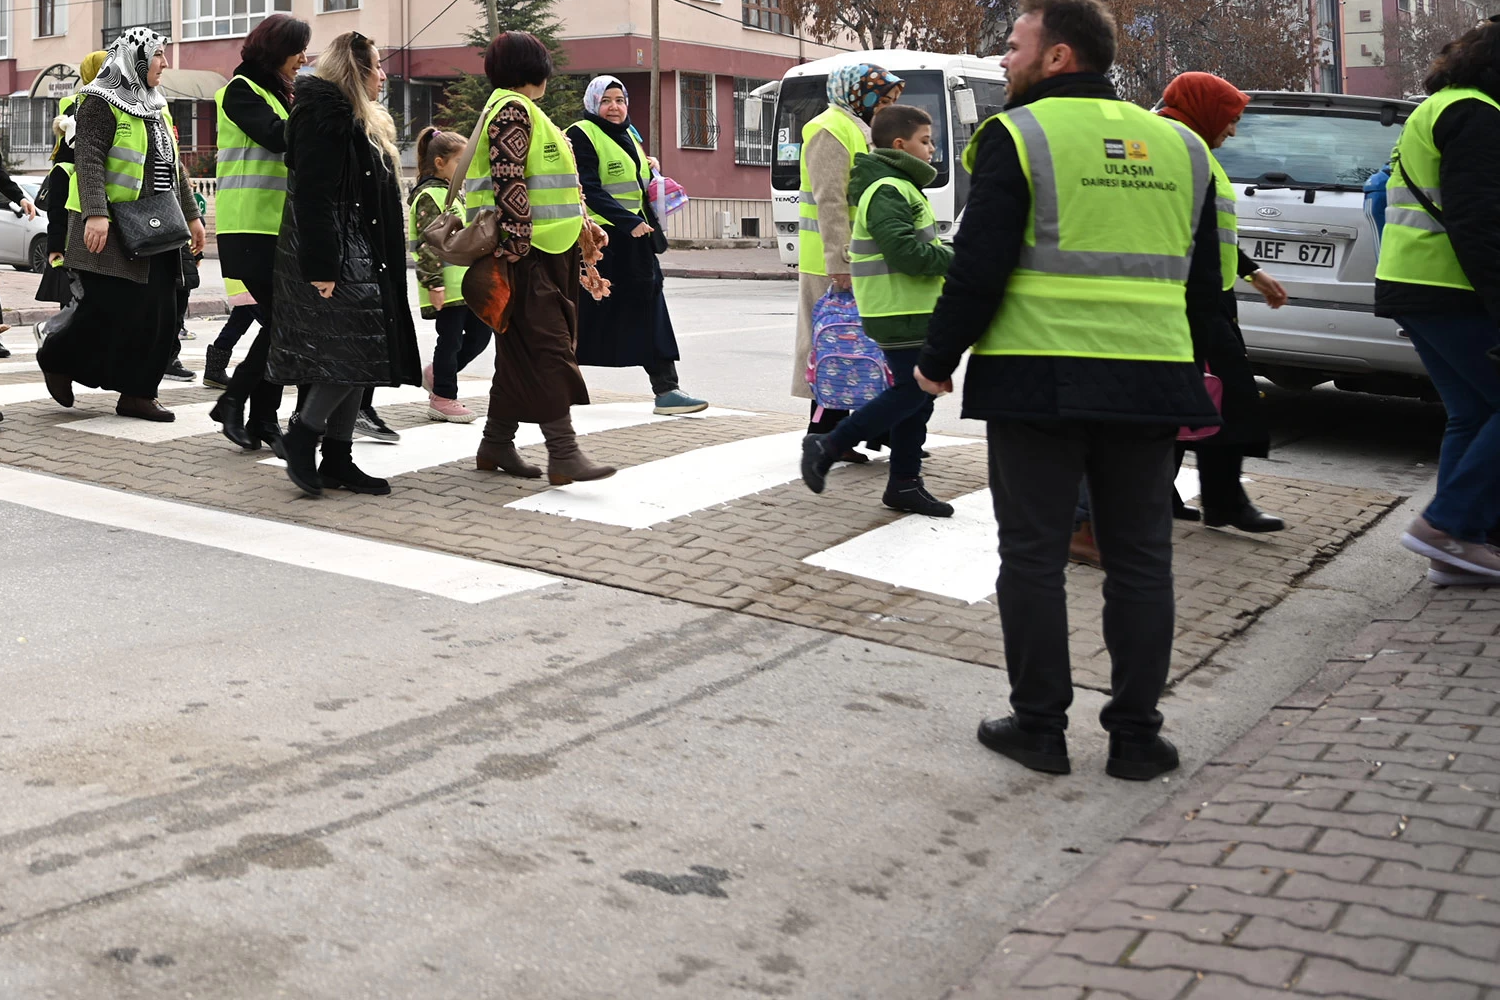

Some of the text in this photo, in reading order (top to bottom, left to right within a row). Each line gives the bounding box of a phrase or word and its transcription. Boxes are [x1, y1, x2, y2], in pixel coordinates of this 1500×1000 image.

[1104, 163, 1154, 178] ULAŞIM
[1253, 240, 1332, 264] AEF 677
